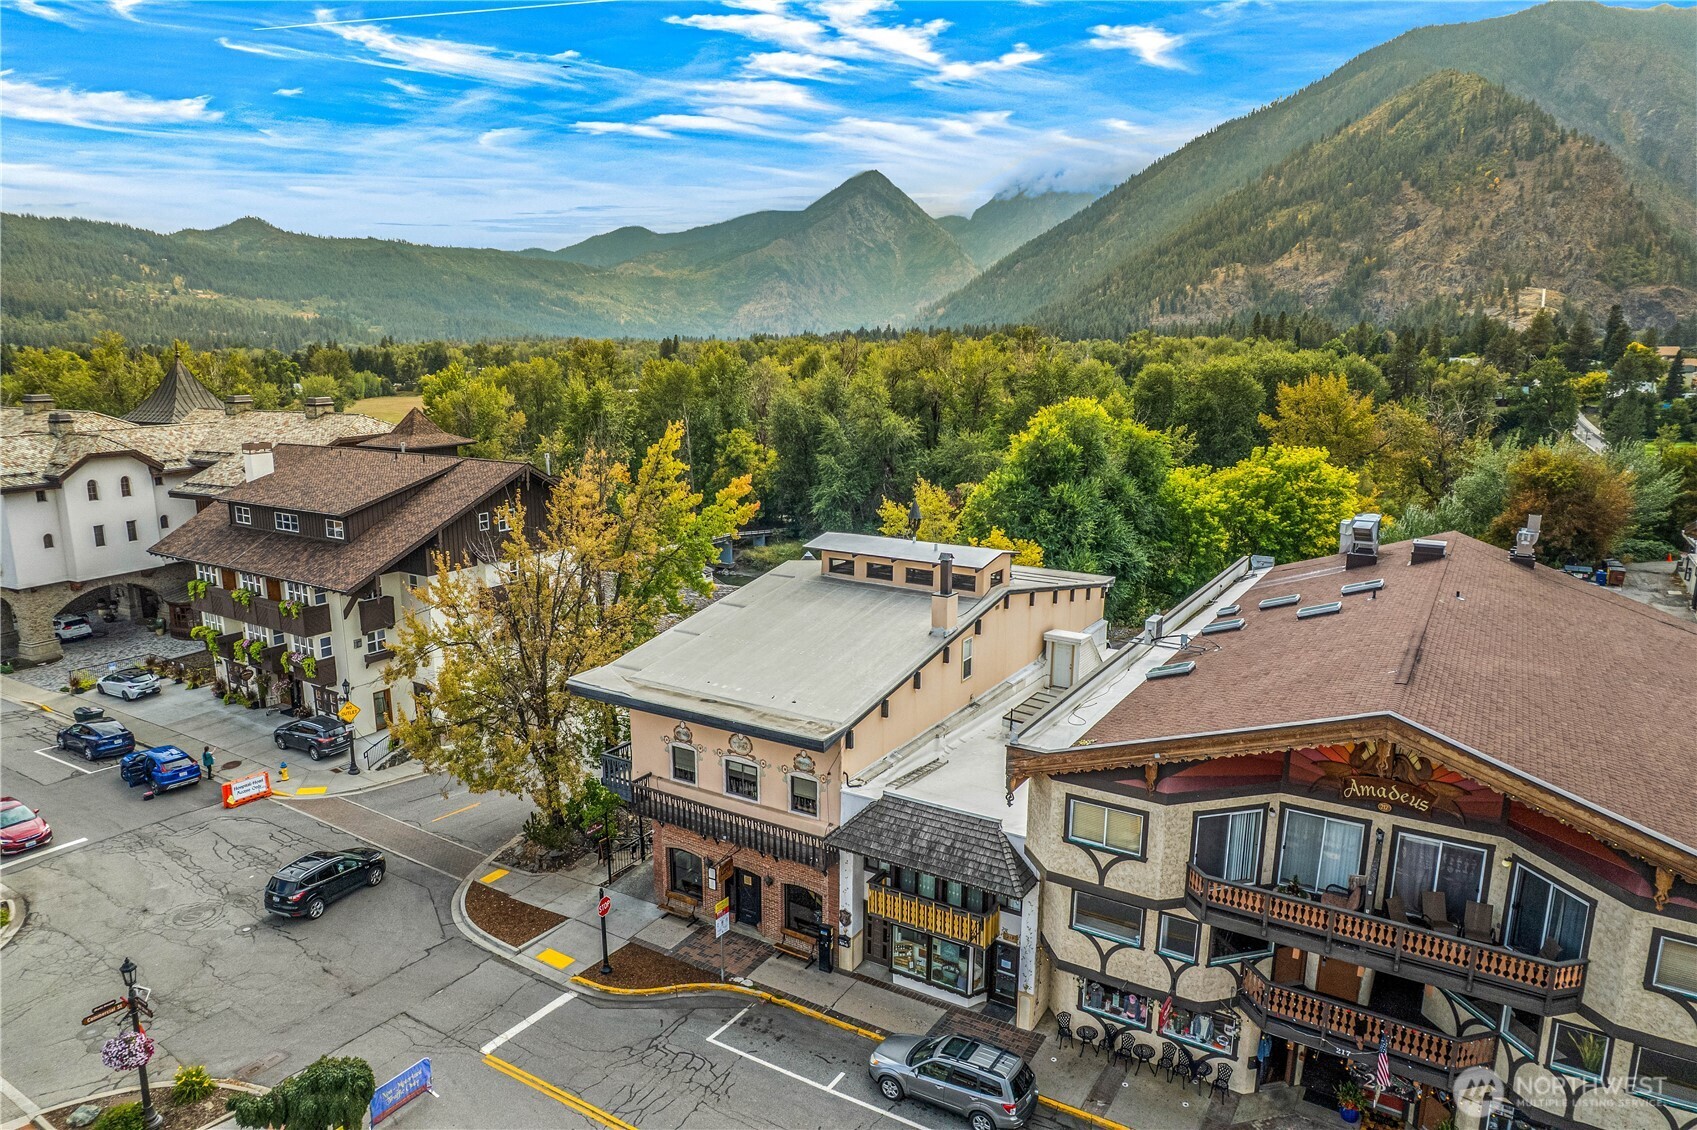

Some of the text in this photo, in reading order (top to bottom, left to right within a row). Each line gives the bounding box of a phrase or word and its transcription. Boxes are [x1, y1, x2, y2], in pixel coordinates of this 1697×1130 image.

[1343, 778, 1429, 812] Amadeus
[598, 900, 611, 913] STOP
[86, 1007, 116, 1023] Commercial
[1336, 1047, 1352, 1056] 217
